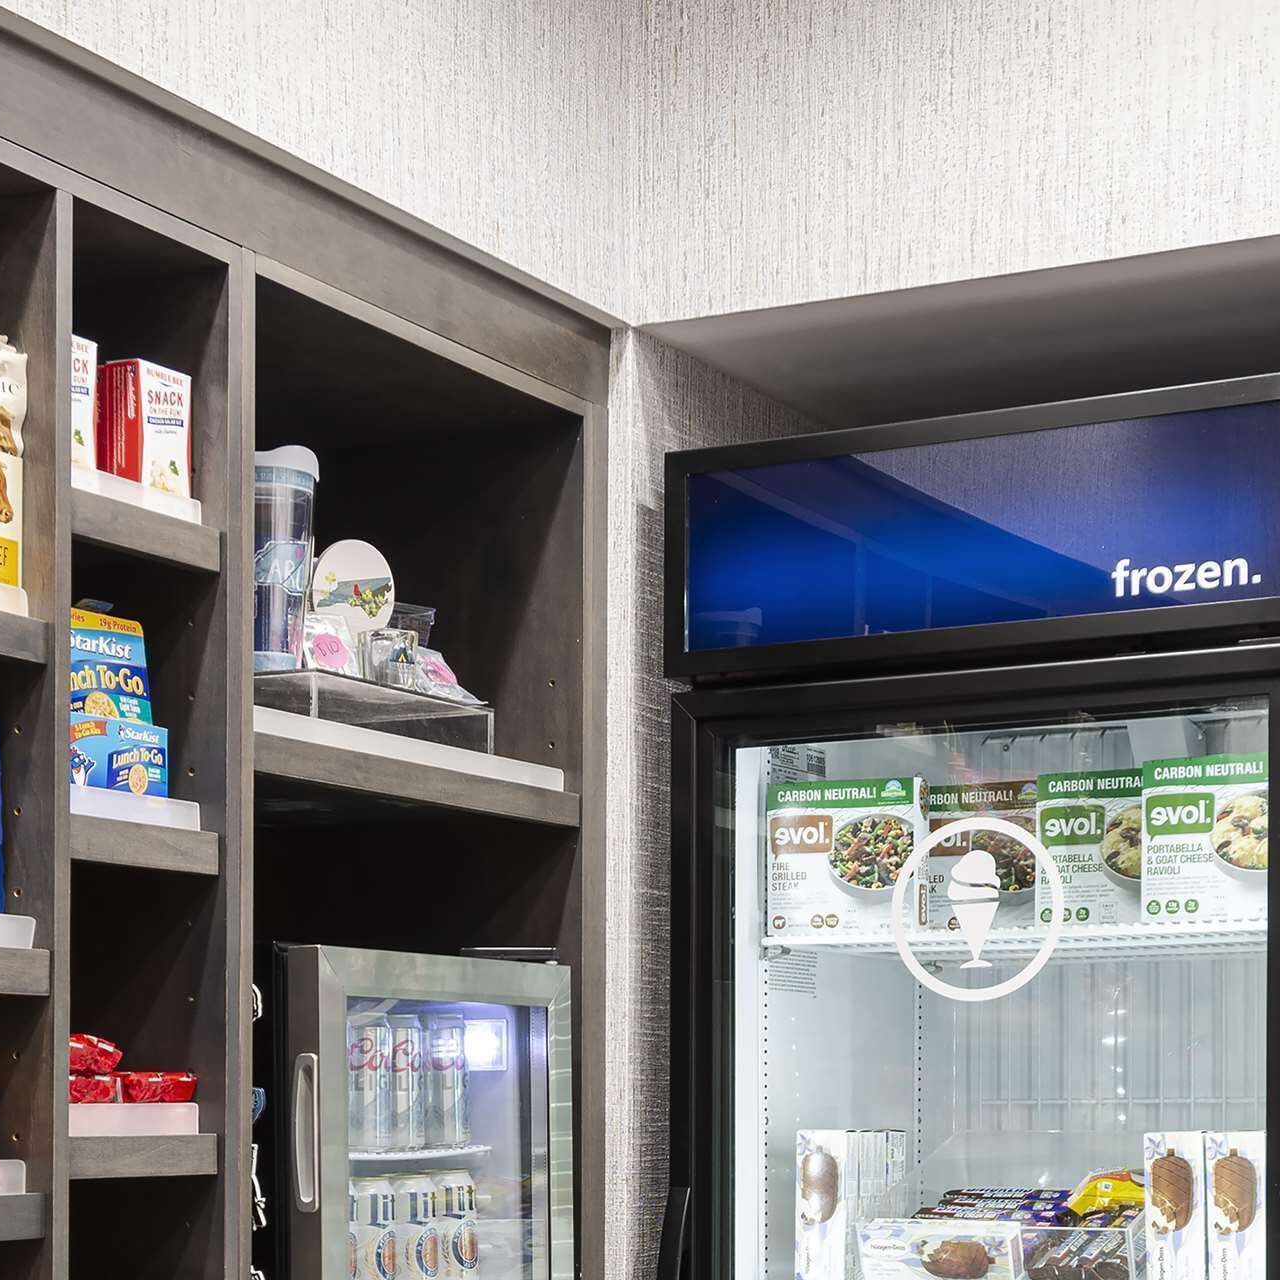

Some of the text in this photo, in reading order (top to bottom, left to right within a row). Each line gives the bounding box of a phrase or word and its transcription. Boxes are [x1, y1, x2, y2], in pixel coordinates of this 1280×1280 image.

[146, 388, 184, 408] SNACK
[1111, 554, 1261, 597] frozen.
[113, 619, 137, 634] Protein
[124, 726, 159, 744] StarKist
[113, 750, 140, 769] Lunch
[1154, 761, 1264, 780] CARBON NEUTRAL!
[778, 787, 876, 802] CARBON NEUTRAL!
[1146, 844, 1203, 854] PORTABELLA
[1155, 853, 1213, 863] GOAT CHEESE
[772, 872, 807, 881] GRILLED
[1146, 865, 1180, 876] RAVIOLI
